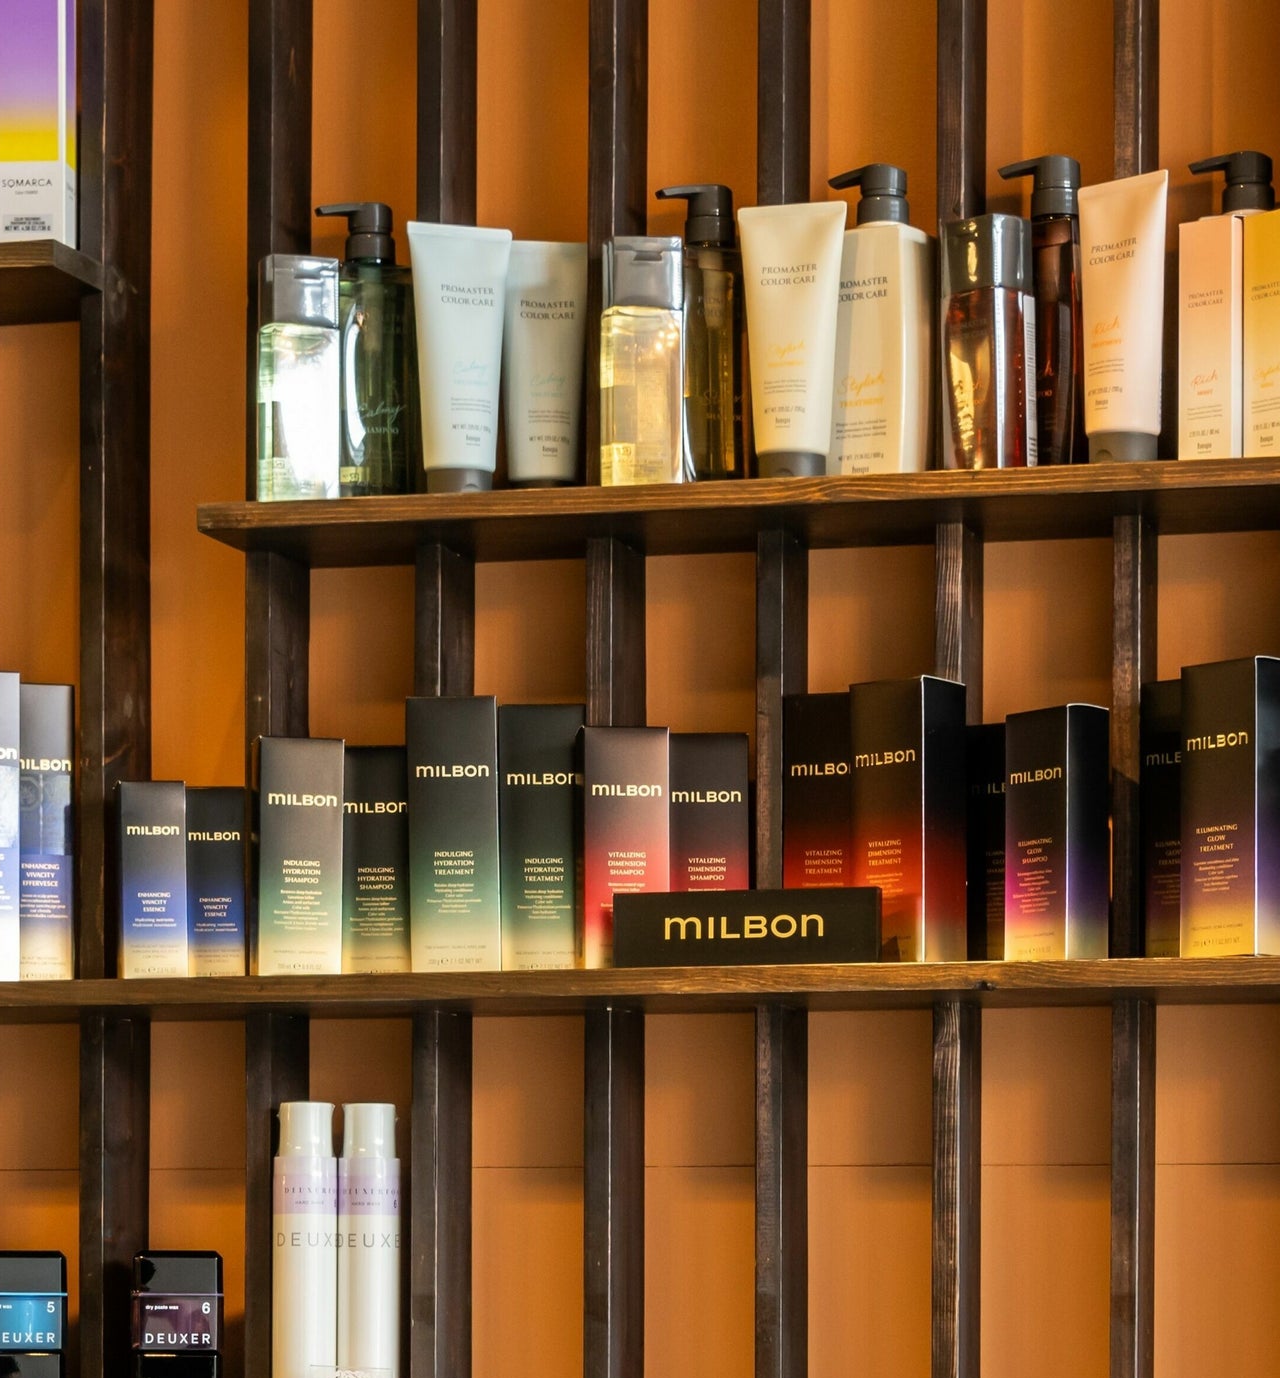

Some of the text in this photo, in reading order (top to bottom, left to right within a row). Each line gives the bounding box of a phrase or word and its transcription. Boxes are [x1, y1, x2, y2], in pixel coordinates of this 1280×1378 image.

[2, 179, 52, 188] SOMARCA
[1091, 238, 1136, 253] PROMASTER
[1090, 250, 1135, 266] COLOR CARE
[762, 264, 817, 274] PROMASTER
[761, 276, 815, 286] COLOR CARE
[840, 276, 888, 290] ROMASTER
[441, 284, 494, 294] PROMASTER
[866, 289, 887, 299] CARE
[1189, 290, 1224, 299] PROMASTER
[442, 296, 494, 306] COLOR CARE
[520, 300, 575, 308] PROMASTER
[1188, 300, 1206, 308] COLOR
[520, 312, 575, 320] COLOR CARE
[1190, 369, 1217, 390] Rich
[1187, 732, 1248, 751] MILBON
[856, 749, 915, 768] MILBON
[416, 765, 489, 777] MILBON
[792, 763, 850, 776] MILBO
[1010, 767, 1061, 785] MILBON
[592, 784, 662, 796] MILBON
[268, 793, 337, 807] MILBON
[672, 791, 741, 803] MILBON
[127, 825, 180, 836] MILBON
[188, 831, 240, 841] MILBON
[868, 840, 901, 848] VITALIZING
[1200, 843, 1233, 852] TREATMENT
[868, 849, 901, 857] DIMENSION
[868, 858, 901, 866] TREATMENT
[665, 914, 824, 940] MILBON
[47, 1302, 55, 1312] 5
[202, 1303, 210, 1313] 6
[146, 1333, 210, 1344] DEUXER
